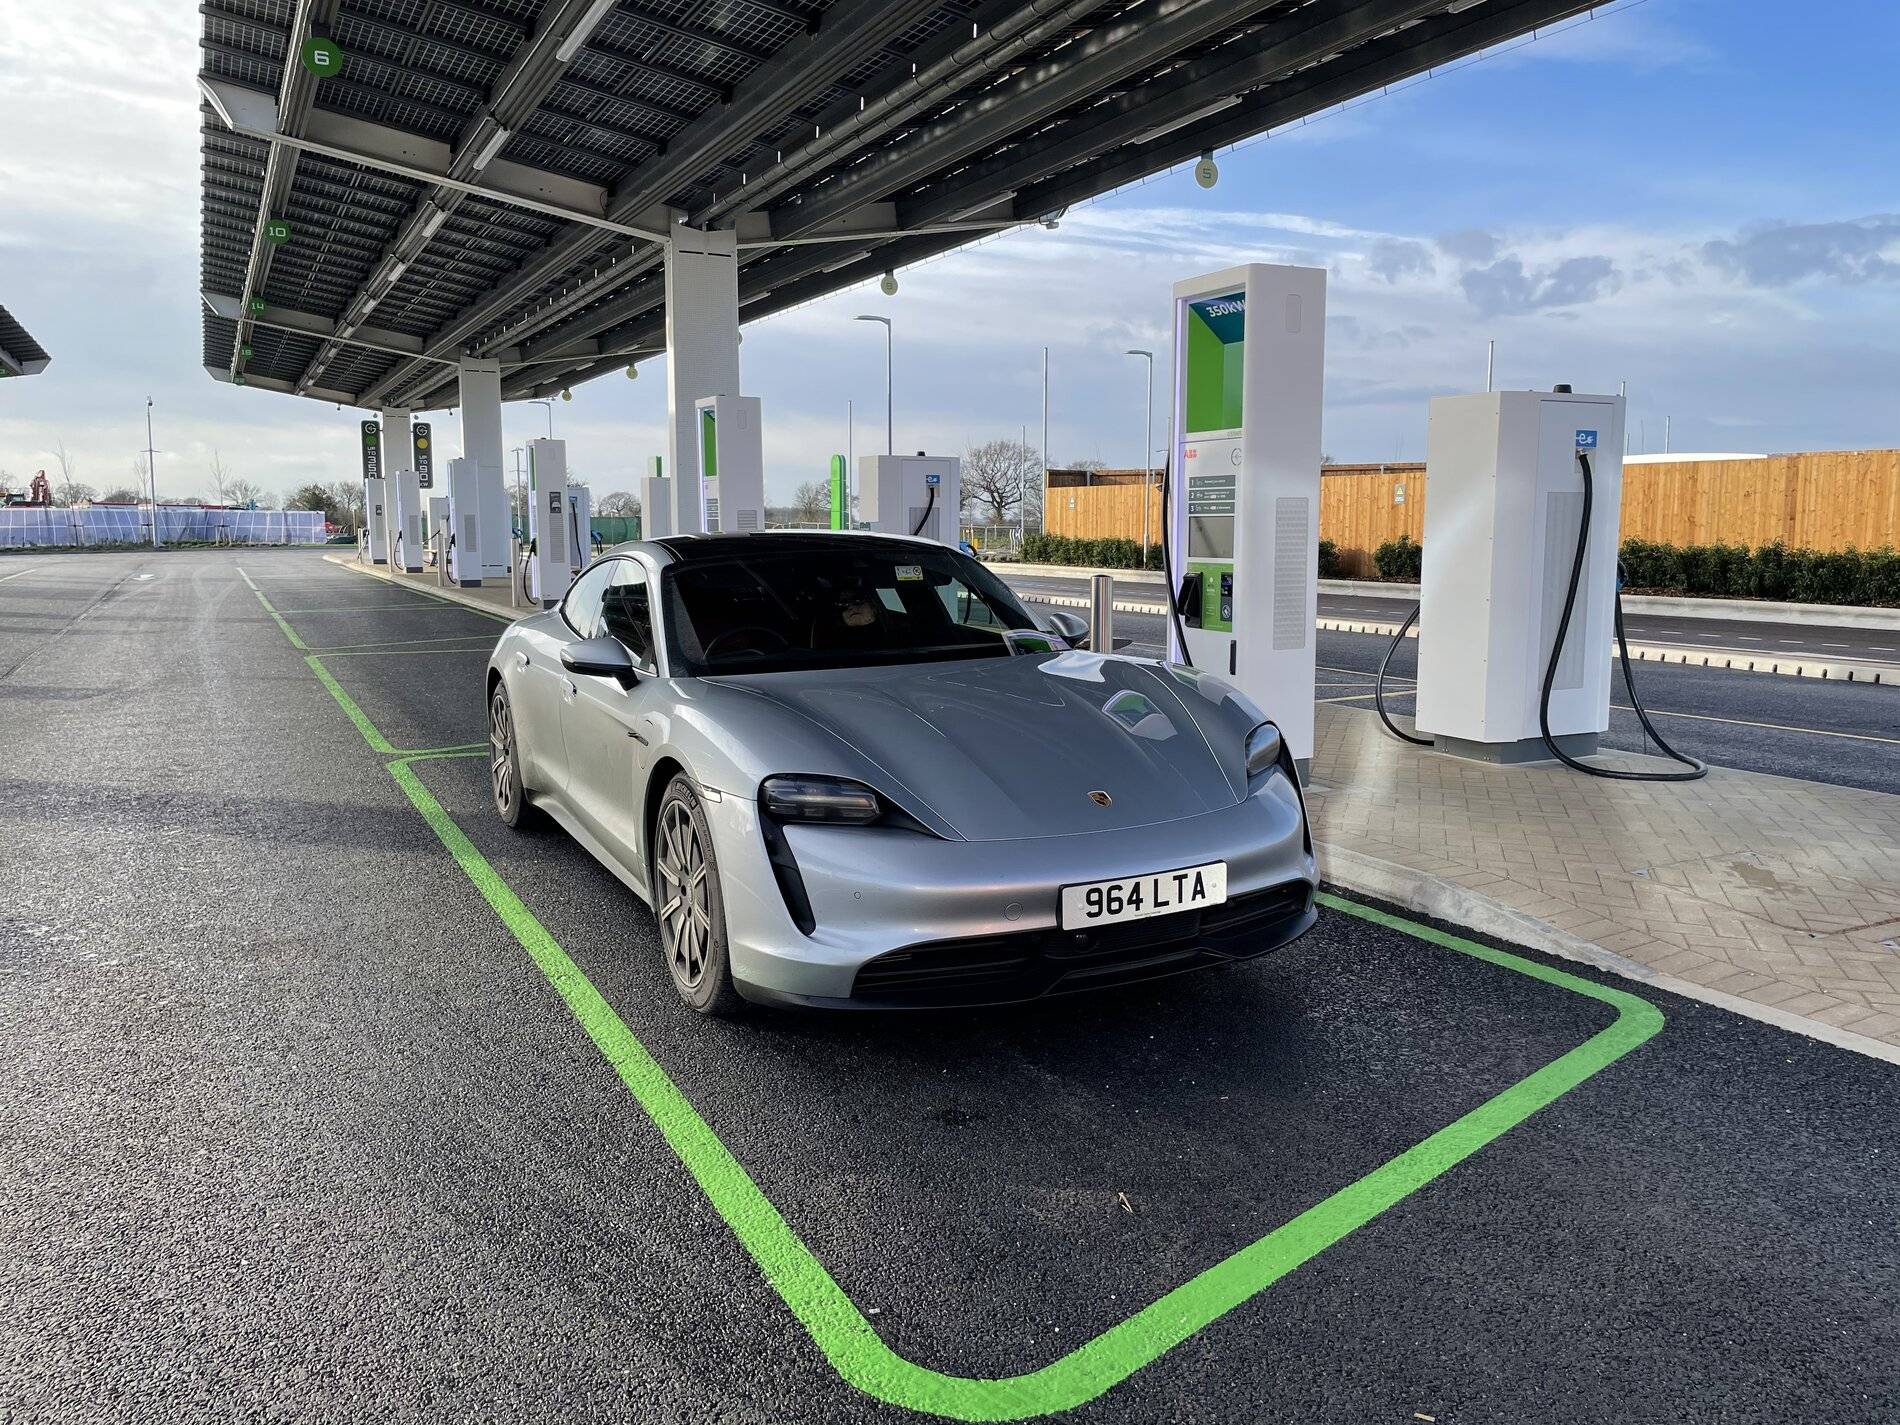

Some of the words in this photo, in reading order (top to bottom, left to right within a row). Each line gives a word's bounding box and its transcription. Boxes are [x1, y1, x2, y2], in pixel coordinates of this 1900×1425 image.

[314, 50, 330, 65] 6
[1202, 168, 1211, 179] 5
[269, 226, 286, 237] 10
[251, 302, 264, 310] 14
[1205, 299, 1246, 318] 350kW
[1085, 881, 1144, 918] 964
[1153, 871, 1206, 909] LTA
